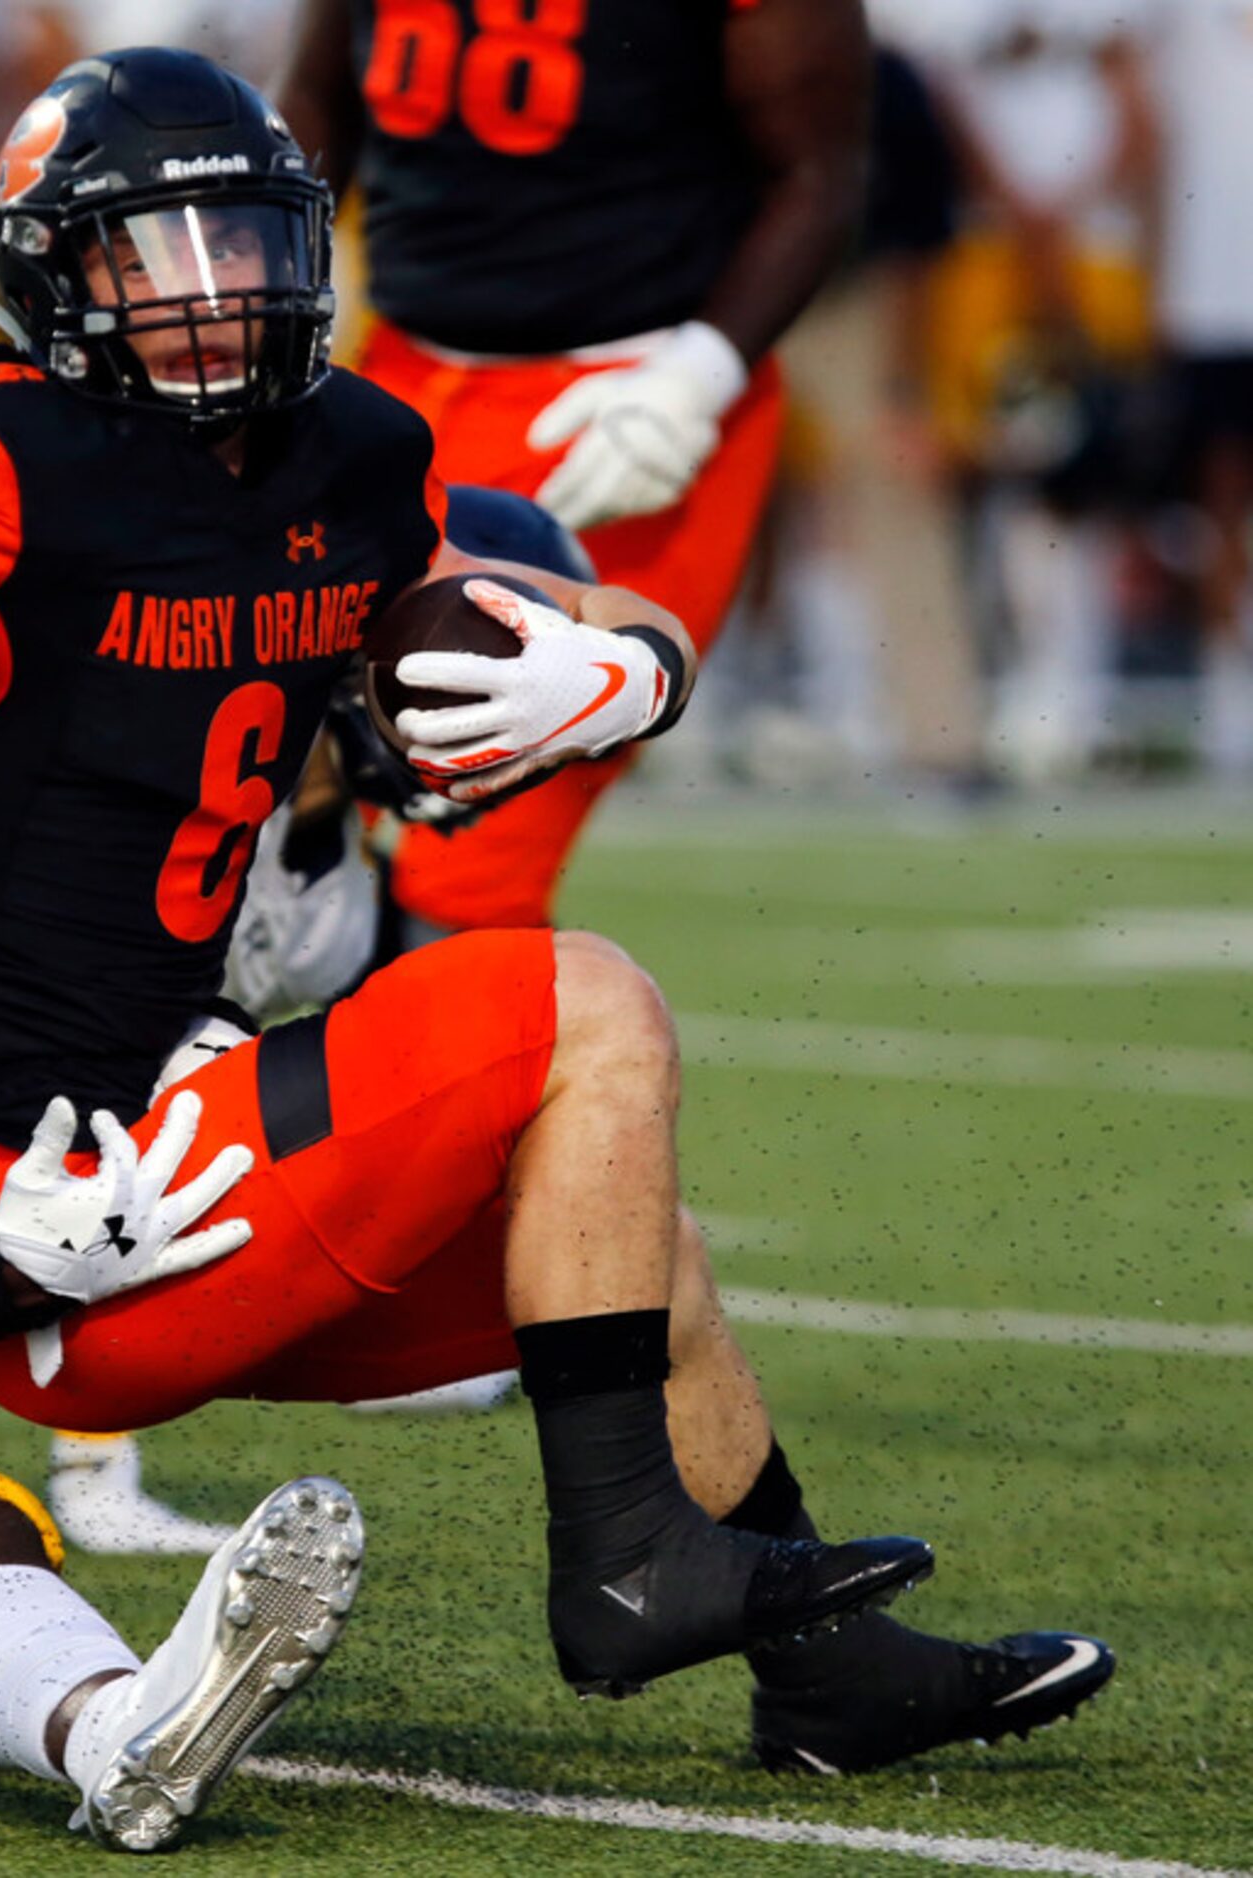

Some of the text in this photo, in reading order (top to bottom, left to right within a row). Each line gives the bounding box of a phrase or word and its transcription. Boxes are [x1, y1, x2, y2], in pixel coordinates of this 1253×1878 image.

[362, 0, 587, 156] 68
[162, 154, 249, 179] Riddell
[96, 580, 379, 669] ANGRY ORANGE
[156, 680, 285, 942] 6
